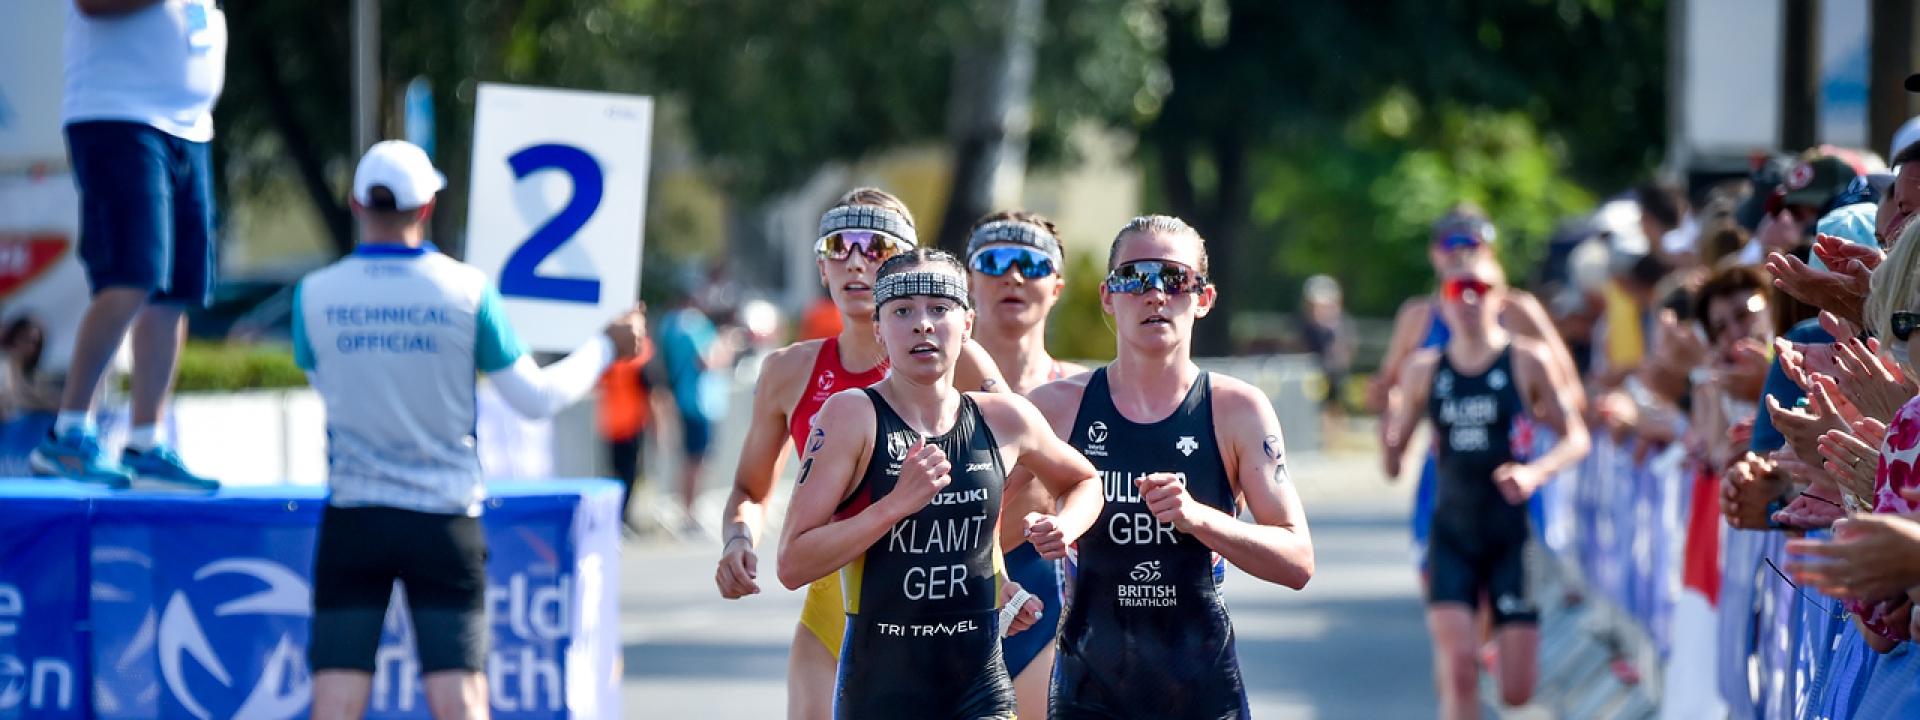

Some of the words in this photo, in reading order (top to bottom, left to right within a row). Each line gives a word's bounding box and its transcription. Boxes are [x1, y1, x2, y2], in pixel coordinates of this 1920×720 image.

[500, 143, 604, 304] 2
[326, 305, 451, 325] TECHNICAL
[337, 332, 439, 353] OFFICIAL
[929, 488, 988, 505] UZUKI
[888, 513, 987, 553] KLAMT
[1109, 512, 1178, 544] GBR
[903, 564, 968, 600] GER
[1118, 585, 1177, 598] BRITISH
[1118, 598, 1177, 607] TRIATHLON
[878, 623, 906, 637] TRI
[910, 620, 978, 637] TRAVEL
